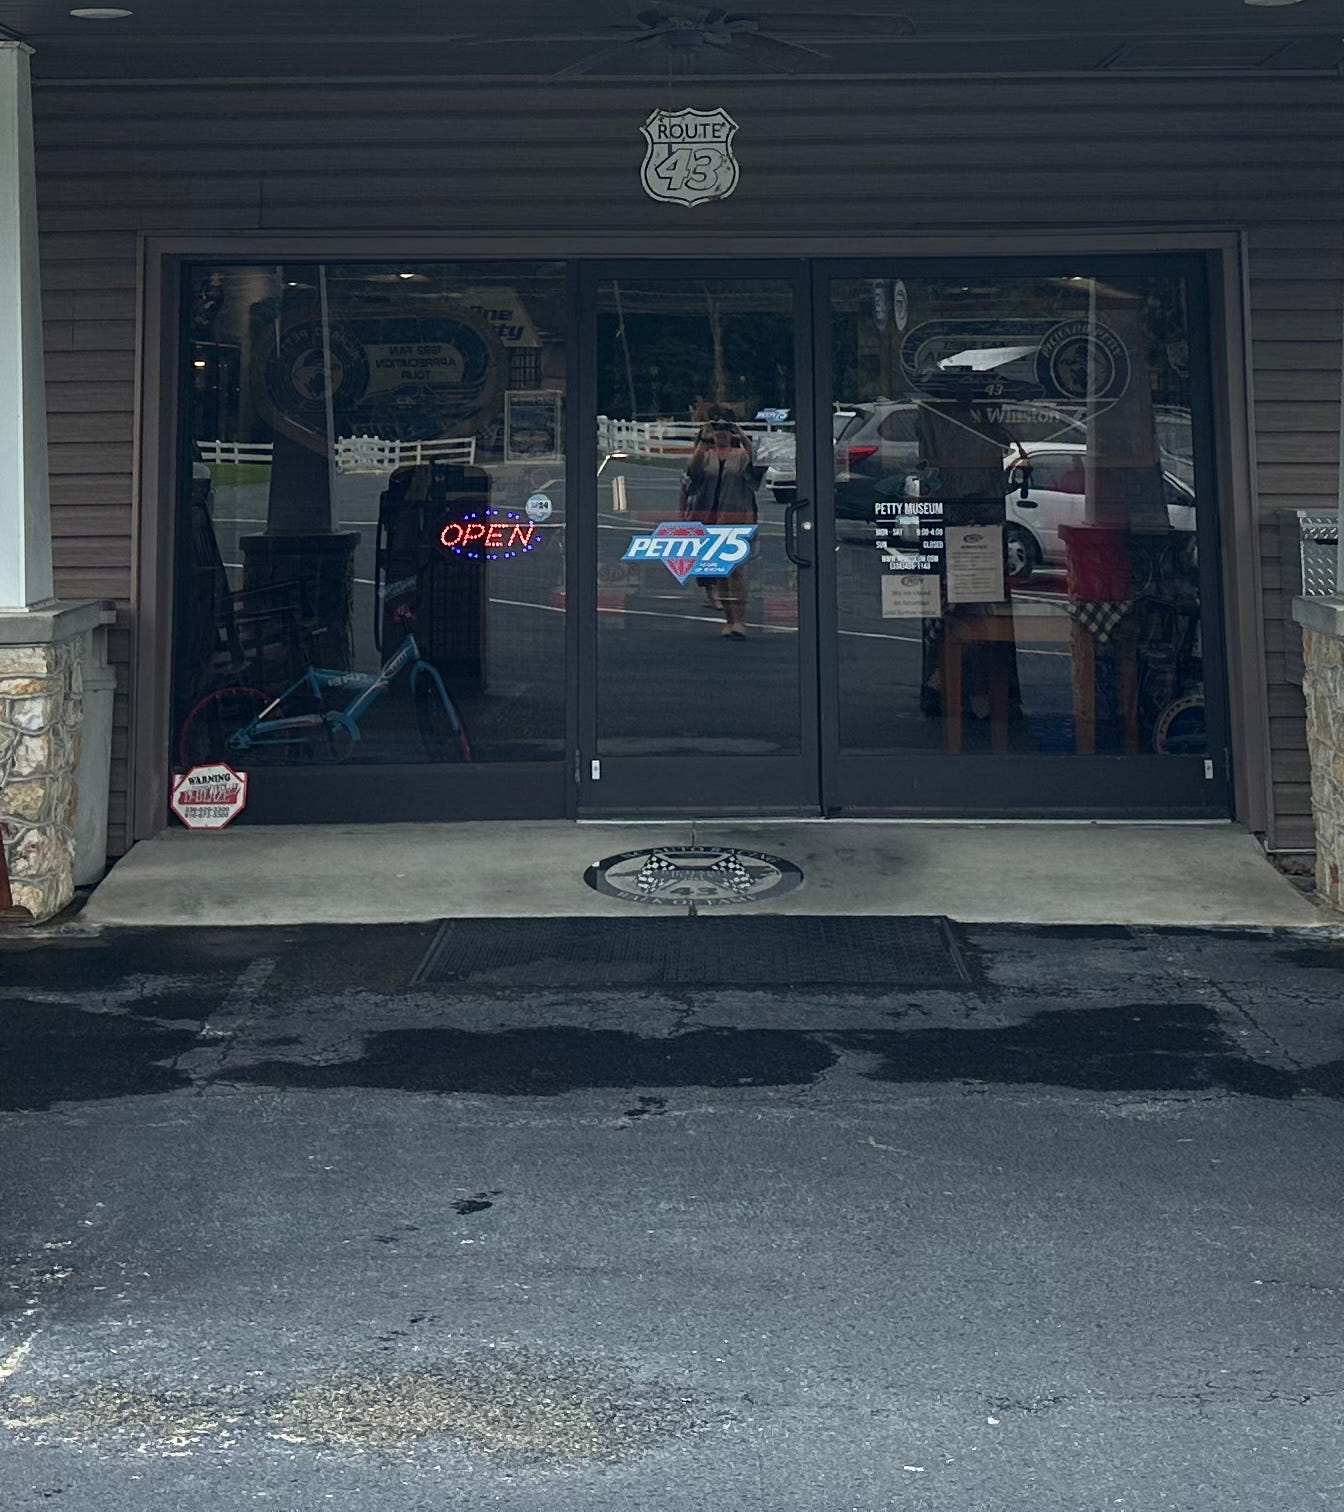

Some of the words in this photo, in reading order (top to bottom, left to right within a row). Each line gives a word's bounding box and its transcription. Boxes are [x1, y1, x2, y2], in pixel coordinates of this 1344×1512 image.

[657, 122, 722, 140] ROUTE
[654, 147, 724, 191] 43
[875, 502, 902, 515] PETTY
[904, 502, 944, 515] MUSEUM
[440, 523, 535, 548] OPEN
[628, 536, 710, 558] PETTY
[704, 525, 753, 562] 75
[188, 773, 231, 785] WARNING
